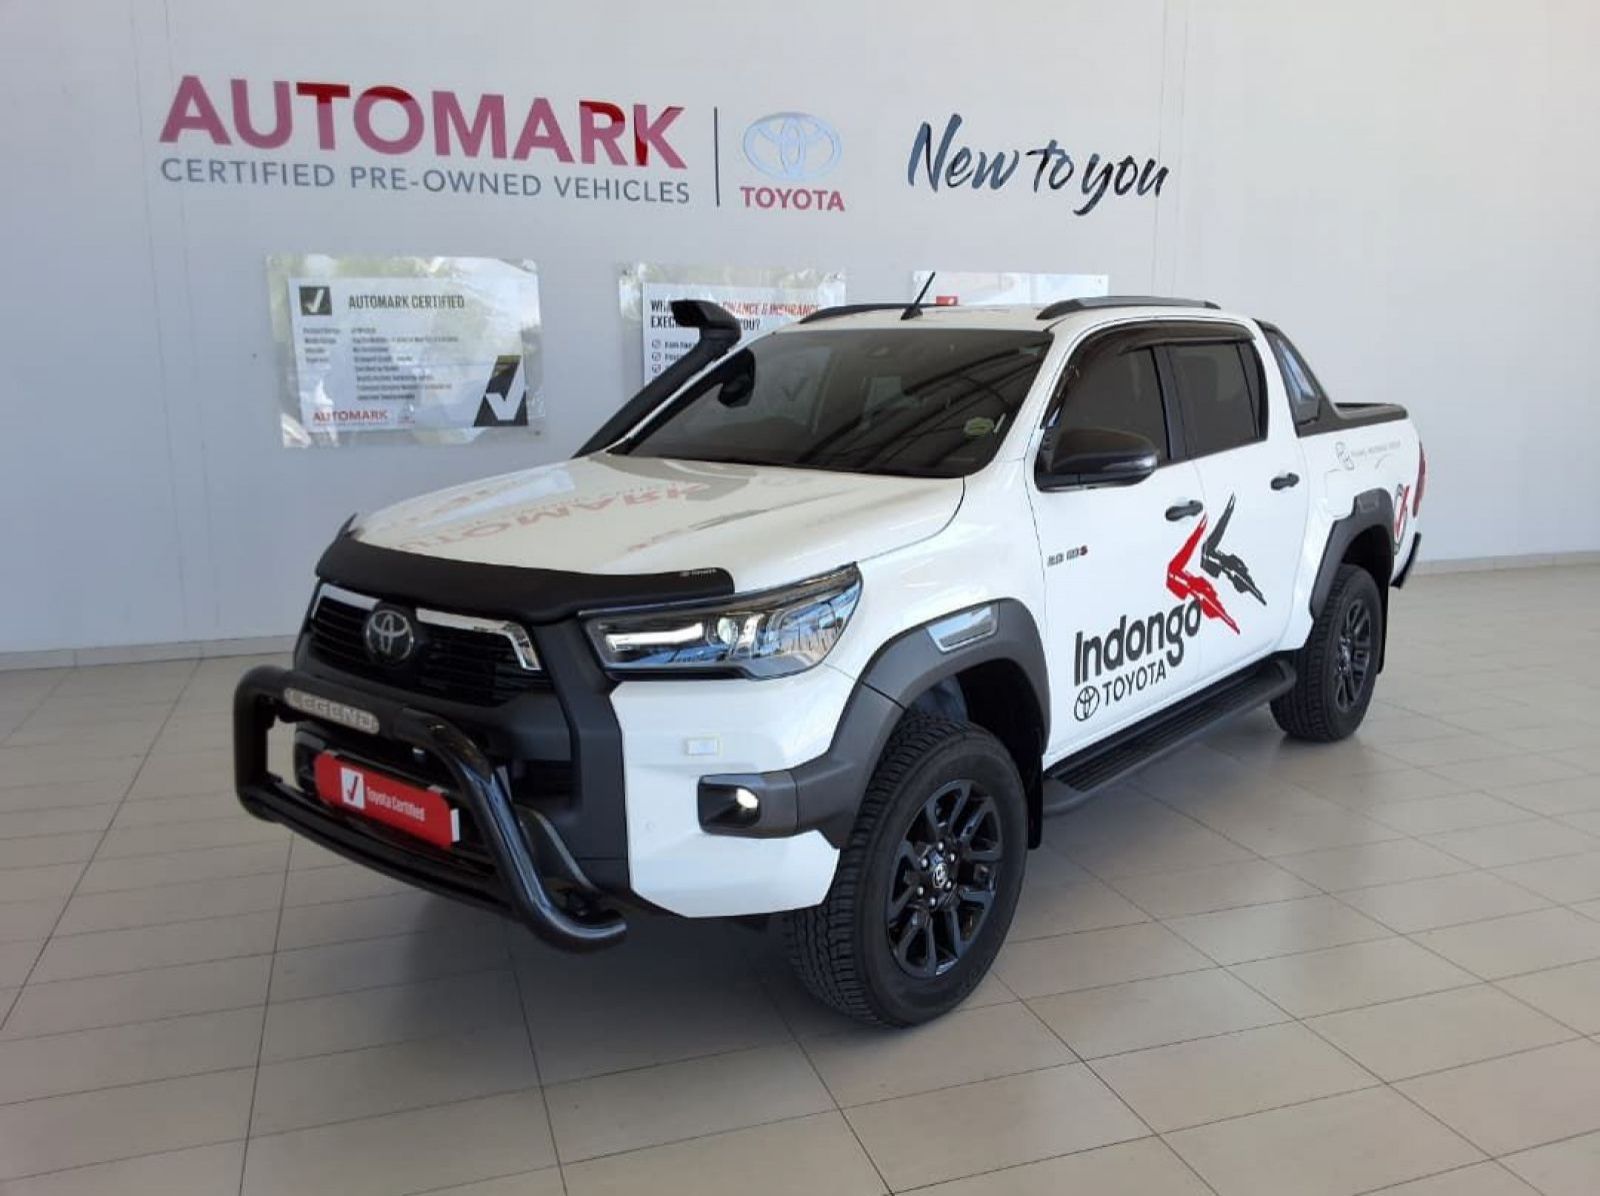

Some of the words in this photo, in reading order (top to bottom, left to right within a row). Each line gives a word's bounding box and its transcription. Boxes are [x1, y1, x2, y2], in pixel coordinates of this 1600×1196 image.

[159, 75, 688, 170] AUTOMARK
[160, 157, 335, 188] CERTIFIED
[350, 166, 542, 197] PRE-OWNED
[553, 176, 691, 204] VEHICLES
[907, 113, 1021, 193] New
[1073, 153, 1169, 216] you
[740, 186, 846, 212] TOYOTA
[349, 295, 409, 309] AUTOMARK
[411, 295, 465, 309] CERTIFIED
[313, 410, 388, 421] AUTOMARK
[1074, 602, 1202, 686] Indongo
[1103, 659, 1166, 706] TOYOTA
[392, 795, 425, 821] Certified
